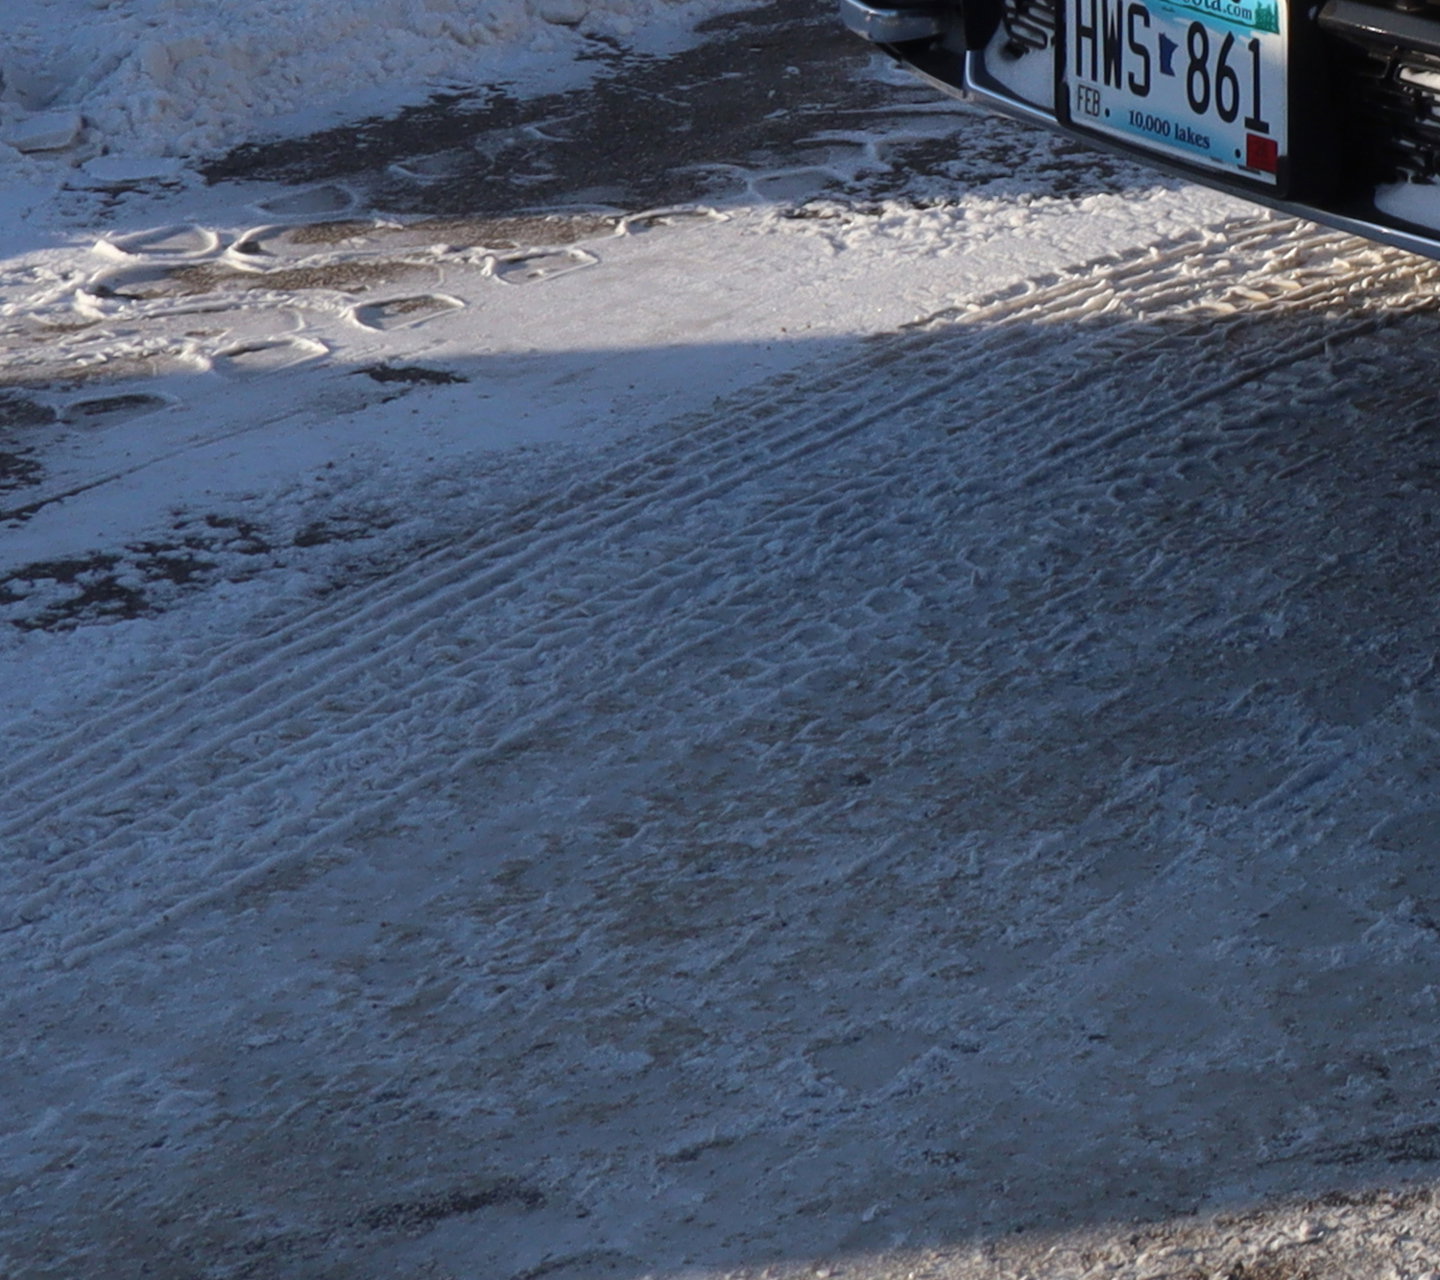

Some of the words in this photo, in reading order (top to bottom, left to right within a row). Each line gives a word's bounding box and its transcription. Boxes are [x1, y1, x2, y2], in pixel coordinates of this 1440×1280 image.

[1186, 20, 1270, 135] 861
[1076, 84, 1101, 118] FEB
[1128, 108, 1171, 137] 10,000
[1174, 122, 1211, 150] lakes
